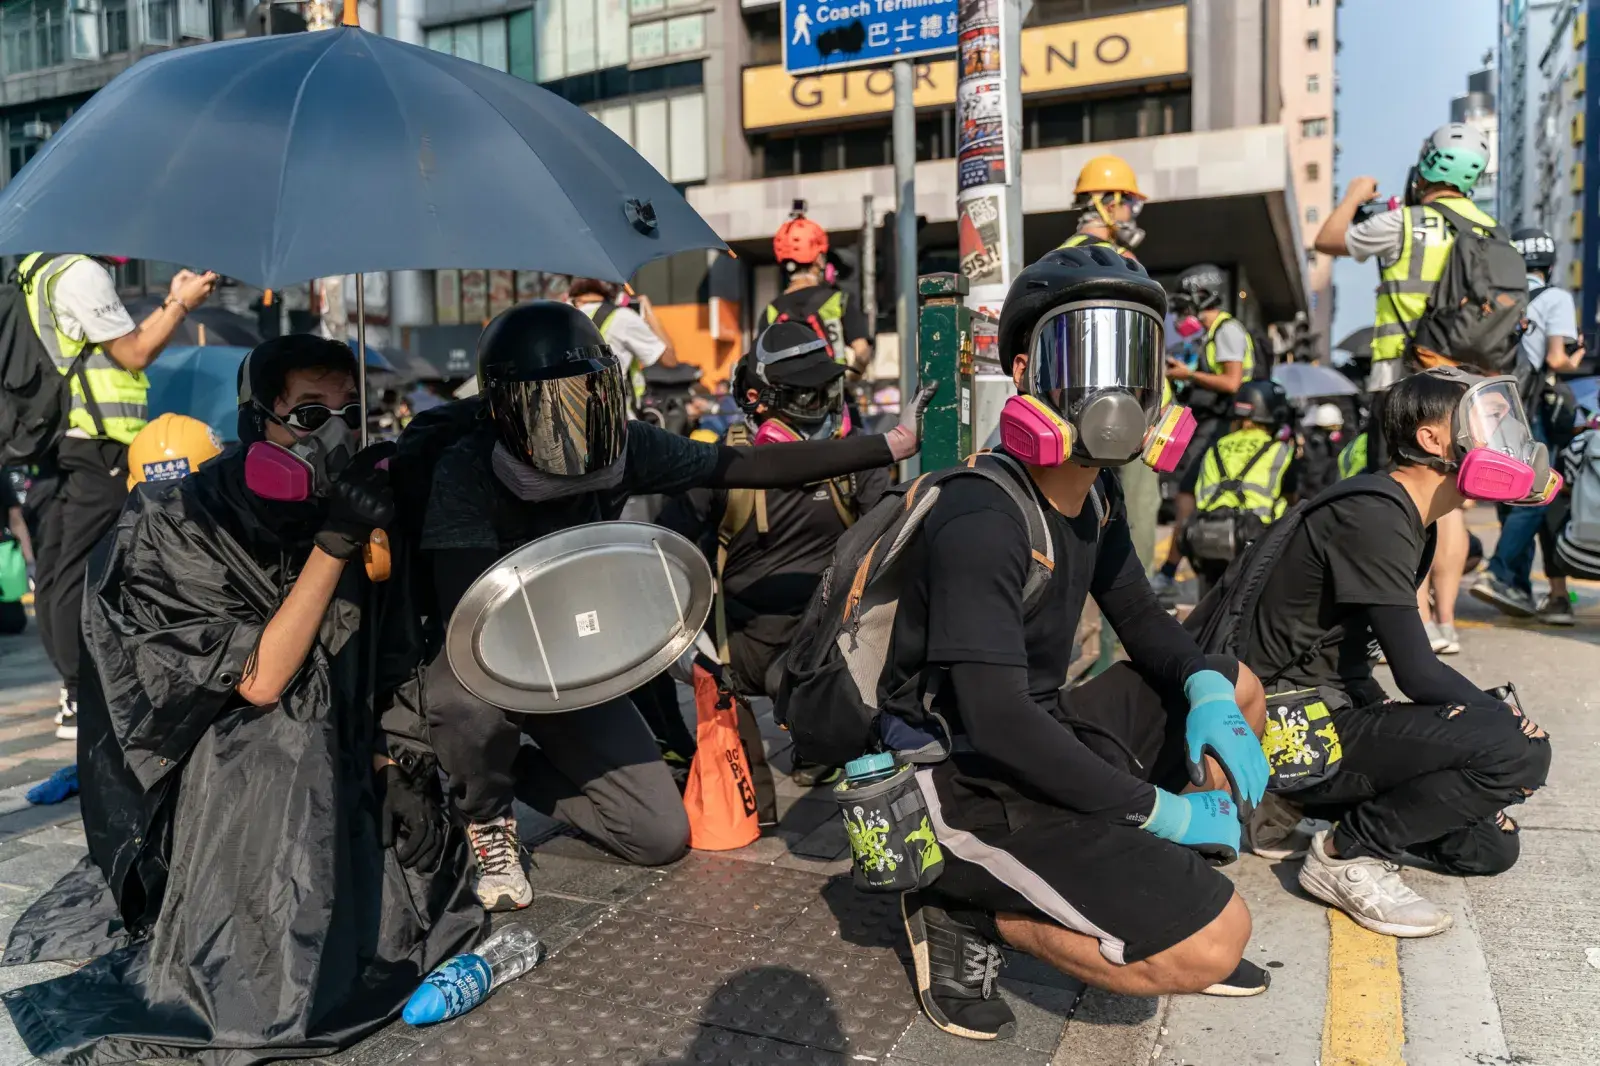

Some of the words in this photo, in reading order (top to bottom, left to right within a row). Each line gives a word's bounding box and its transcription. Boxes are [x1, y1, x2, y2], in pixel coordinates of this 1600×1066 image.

[816, 0, 871, 23] Coach
[873, 0, 954, 13] Termin
[790, 33, 1131, 109] GIORNO
